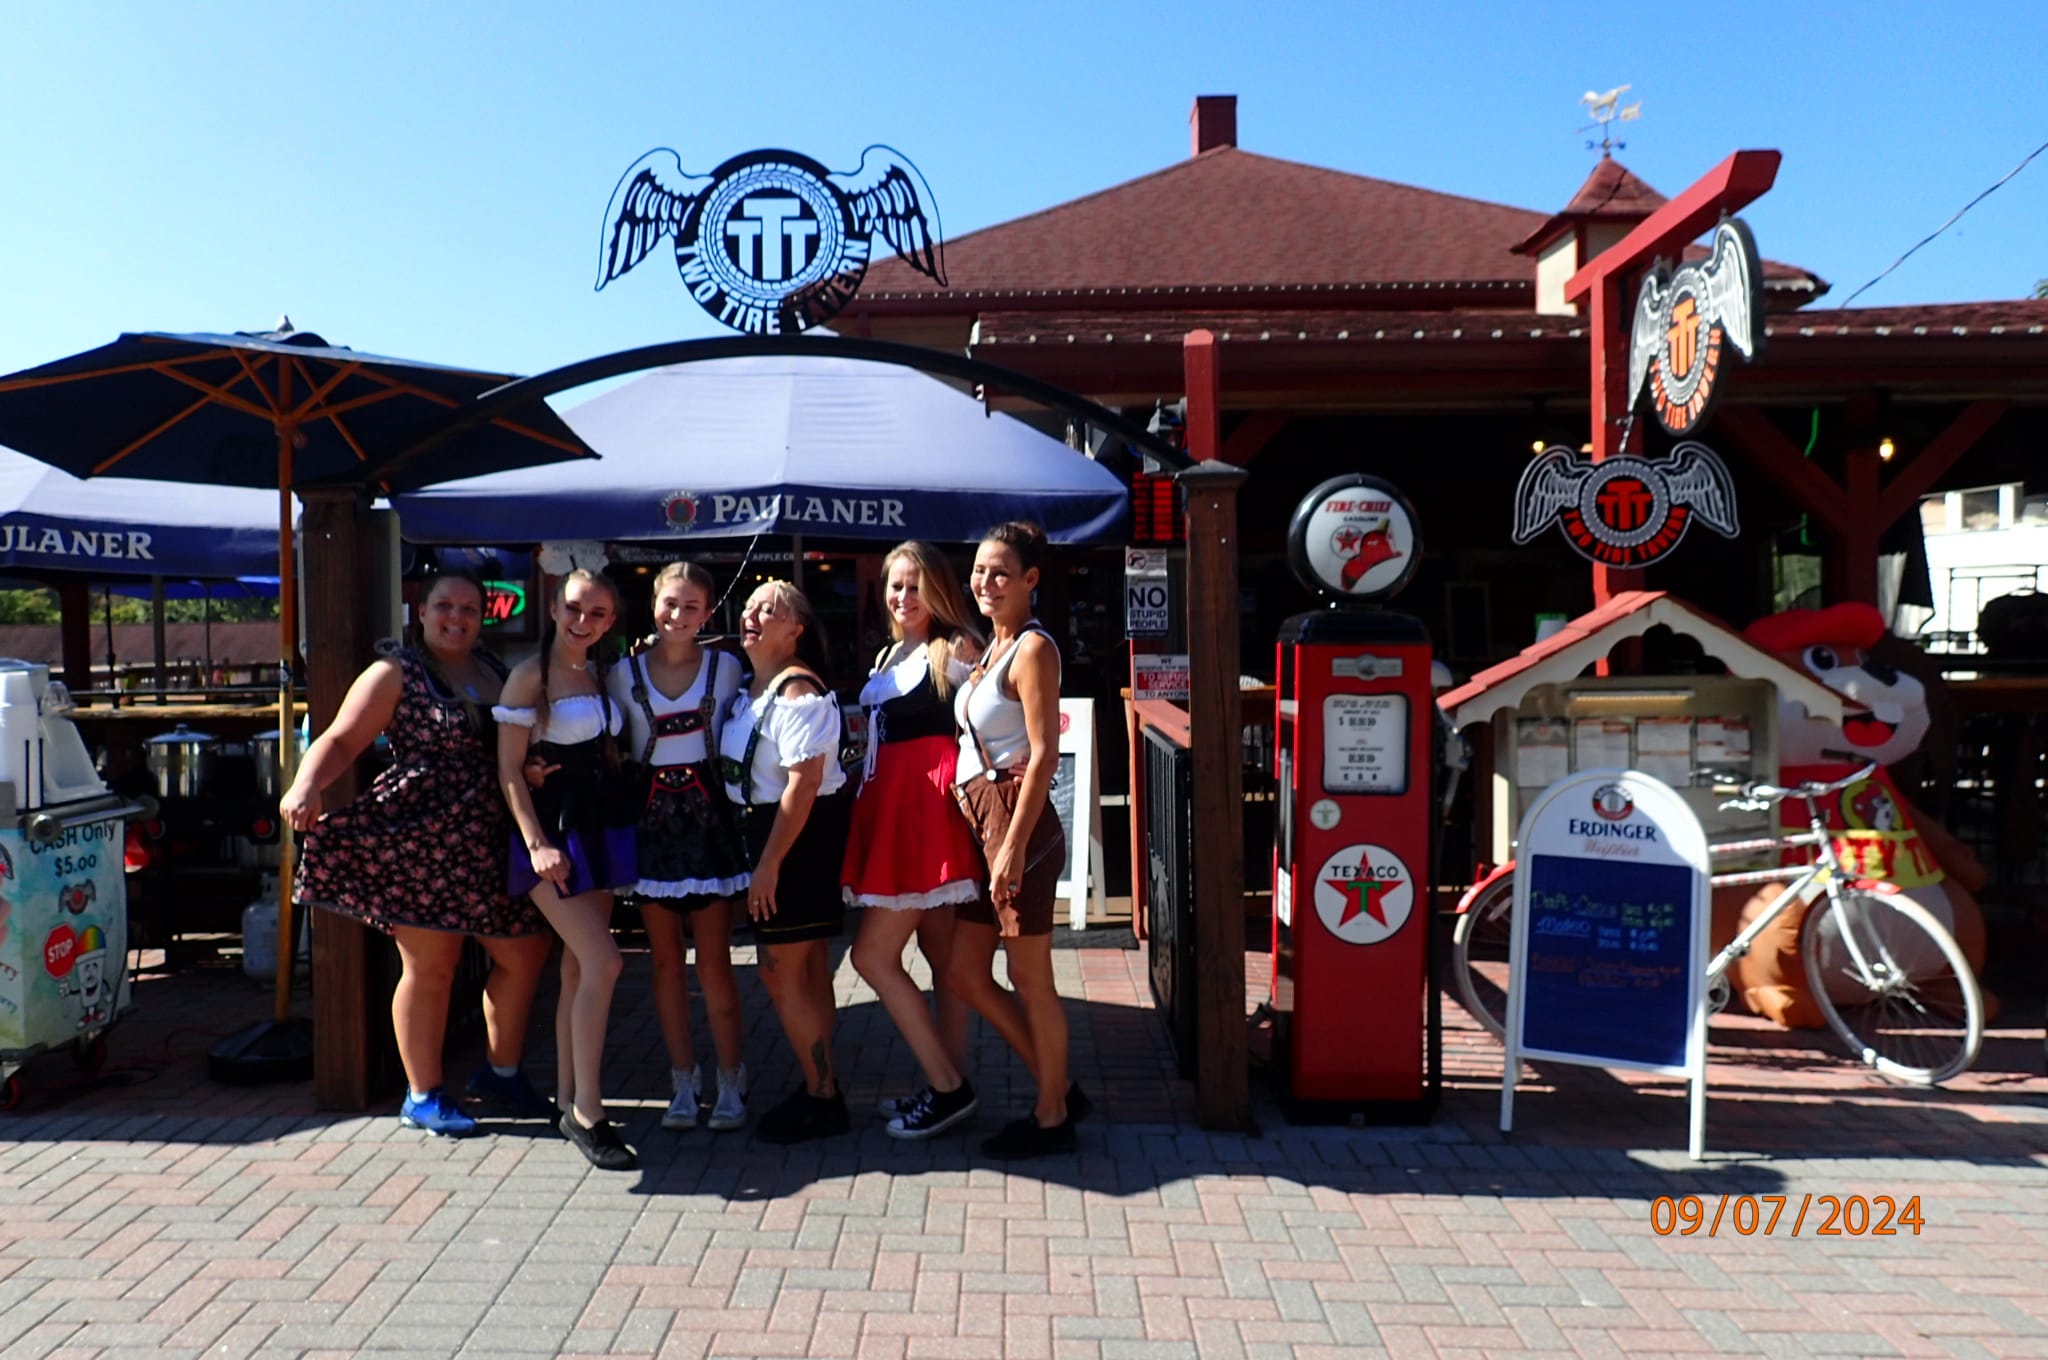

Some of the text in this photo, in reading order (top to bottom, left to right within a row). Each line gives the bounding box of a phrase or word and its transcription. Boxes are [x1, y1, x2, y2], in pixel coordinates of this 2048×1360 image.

[676, 240, 718, 303] TWO
[719, 300, 780, 334] TIRE
[712, 494, 907, 527] PAULANER
[752, 553, 781, 561] APPLE
[1128, 587, 1167, 609] NO
[1129, 610, 1167, 619] STUPID
[1129, 619, 1167, 629] PEOPLE
[82, 820, 116, 842] Only
[1568, 819, 1657, 842] ERDINGER
[55, 854, 97, 877] $5.00
[1331, 865, 1399, 878] TEXACO
[47, 939, 74, 963] STOP
